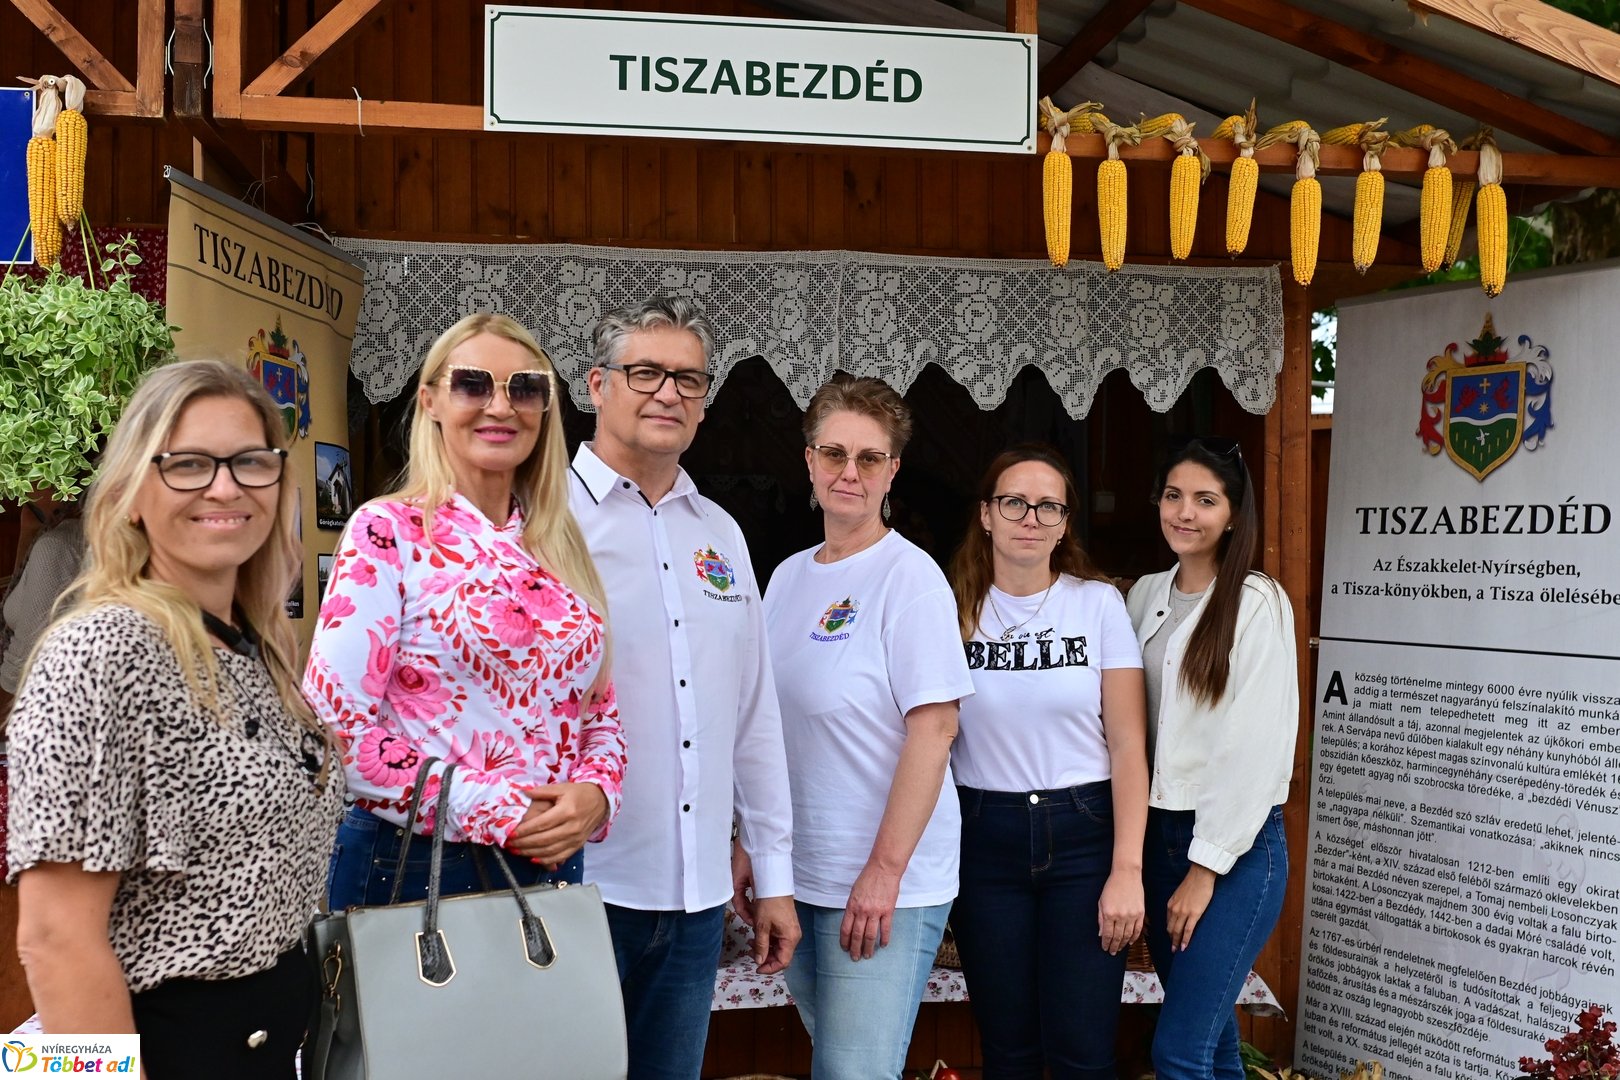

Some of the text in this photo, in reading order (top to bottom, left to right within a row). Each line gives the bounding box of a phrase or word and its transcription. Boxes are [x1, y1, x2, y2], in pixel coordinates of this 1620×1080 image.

[609, 54, 923, 103] TISZABEZDÉD
[1356, 496, 1612, 535] TISZABEZDÉD
[1373, 555, 1581, 578] Az Északkelet-Nyírségben,
[1331, 583, 1338, 595] a
[1342, 581, 1472, 601] Tisza-könyökben,
[1475, 589, 1484, 600] a
[1490, 586, 1534, 602] Tisza
[963, 636, 1089, 671] BELLE
[1323, 670, 1348, 706] A
[1353, 685, 1379, 698] addig
[1390, 688, 1438, 701] természet
[1440, 695, 1499, 710] nagyarányú
[1502, 698, 1575, 716] felszínalakító
[1354, 672, 1387, 686] község
[1390, 675, 1442, 688] történelme
[1445, 680, 1484, 695] mintegy
[1486, 683, 1514, 695] 6000
[1518, 686, 1542, 698] évre
[1545, 689, 1578, 702] nyúlik
[1322, 709, 1346, 721] Amint
[1348, 712, 1395, 726] állandósult
[1407, 719, 1421, 732] táj,
[1424, 723, 1460, 734] azonnal
[1463, 727, 1523, 742] megjelentek
[1527, 735, 1540, 743] az
[1352, 697, 1361, 709] ja
[1368, 700, 1392, 711] miatt
[1400, 705, 1422, 714] nem
[1430, 706, 1495, 722] telepedhetett
[1504, 716, 1528, 728] meg
[1537, 717, 1548, 728] itt
[1556, 721, 1570, 730] az
[1319, 748, 1358, 761] obszidián
[1345, 725, 1381, 740] Servápa
[1445, 737, 1483, 751] kialakult
[1485, 744, 1504, 756] egy
[1506, 745, 1544, 761] néhány
[1546, 749, 1601, 766] kunyhóból
[1369, 741, 1404, 754] korához
[1406, 745, 1436, 759] képest
[1438, 752, 1468, 764] magas
[1470, 756, 1524, 771] színvonalú
[1526, 762, 1560, 776] kultúra
[1562, 769, 1607, 783] emlékét
[1319, 762, 1334, 773] egy
[1335, 763, 1366, 776] égetett
[1367, 770, 1394, 783] agyag
[1396, 773, 1410, 783] női
[1413, 776, 1464, 791] szobrocska
[1467, 782, 1514, 800] töredéke,
[1316, 801, 1326, 809] se
[1410, 815, 1465, 834] Szemantikai
[1316, 812, 1341, 825] ismert
[1362, 821, 1414, 838] máshonnan
[1325, 787, 1363, 802] település
[1365, 796, 1382, 805] mai
[1384, 799, 1407, 811] neve,
[1419, 803, 1453, 817] Bezdéd
[1455, 810, 1472, 821] szó
[1474, 814, 1501, 826] szláv
[1503, 819, 1542, 833] eredetű
[1545, 823, 1574, 840] lehet,
[1408, 848, 1459, 867] hivatalosan
